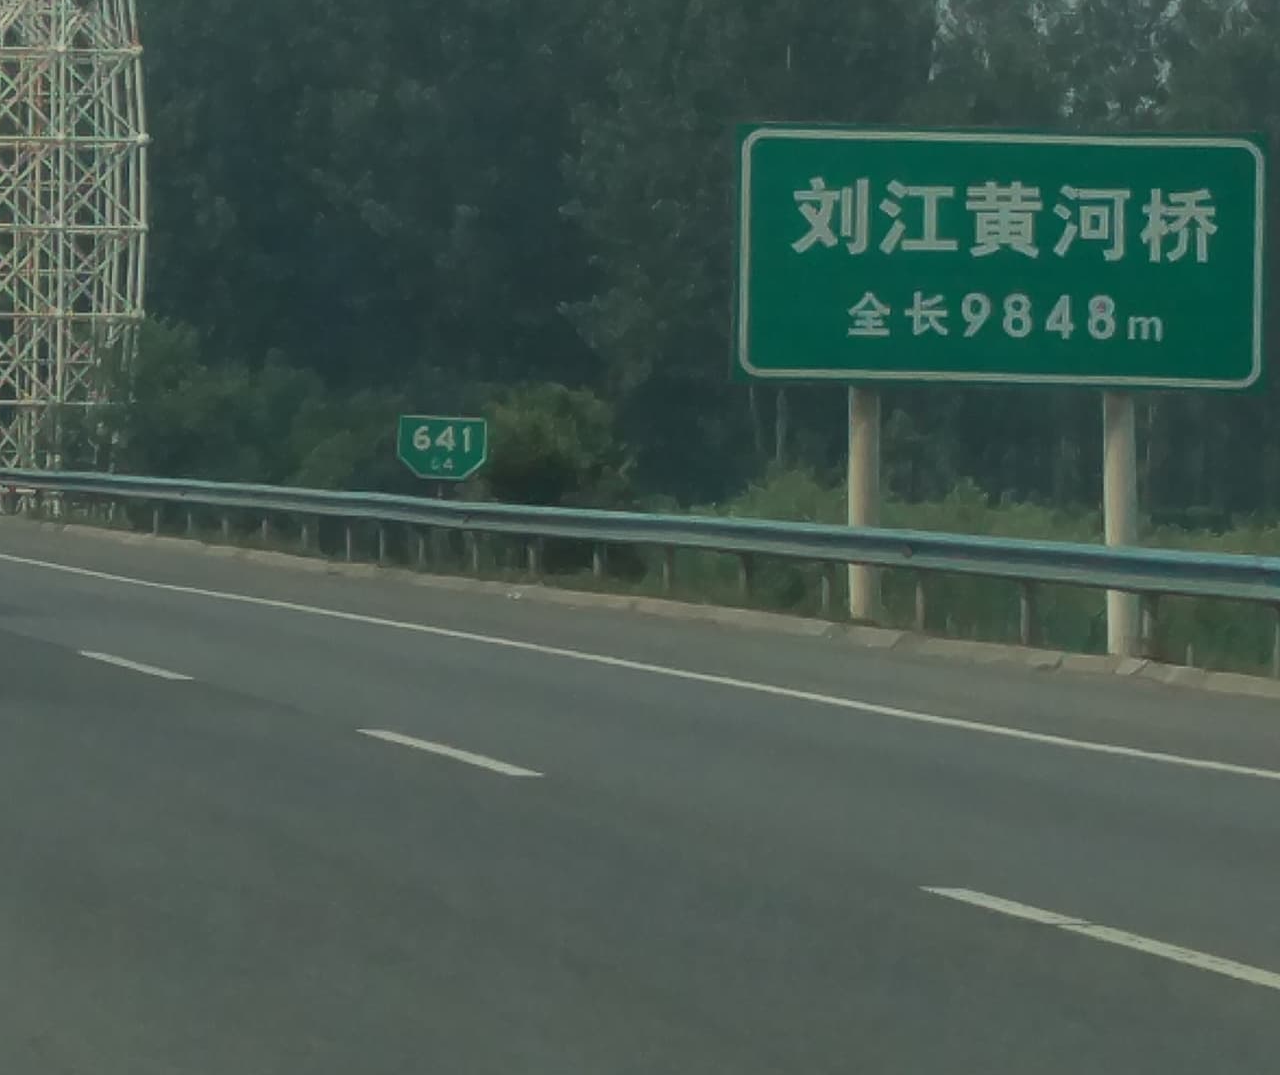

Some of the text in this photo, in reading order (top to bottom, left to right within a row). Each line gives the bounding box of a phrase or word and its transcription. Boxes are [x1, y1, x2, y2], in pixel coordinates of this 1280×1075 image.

[791, 177, 1219, 263] 刘江黄河桥
[412, 425, 472, 453] 641
